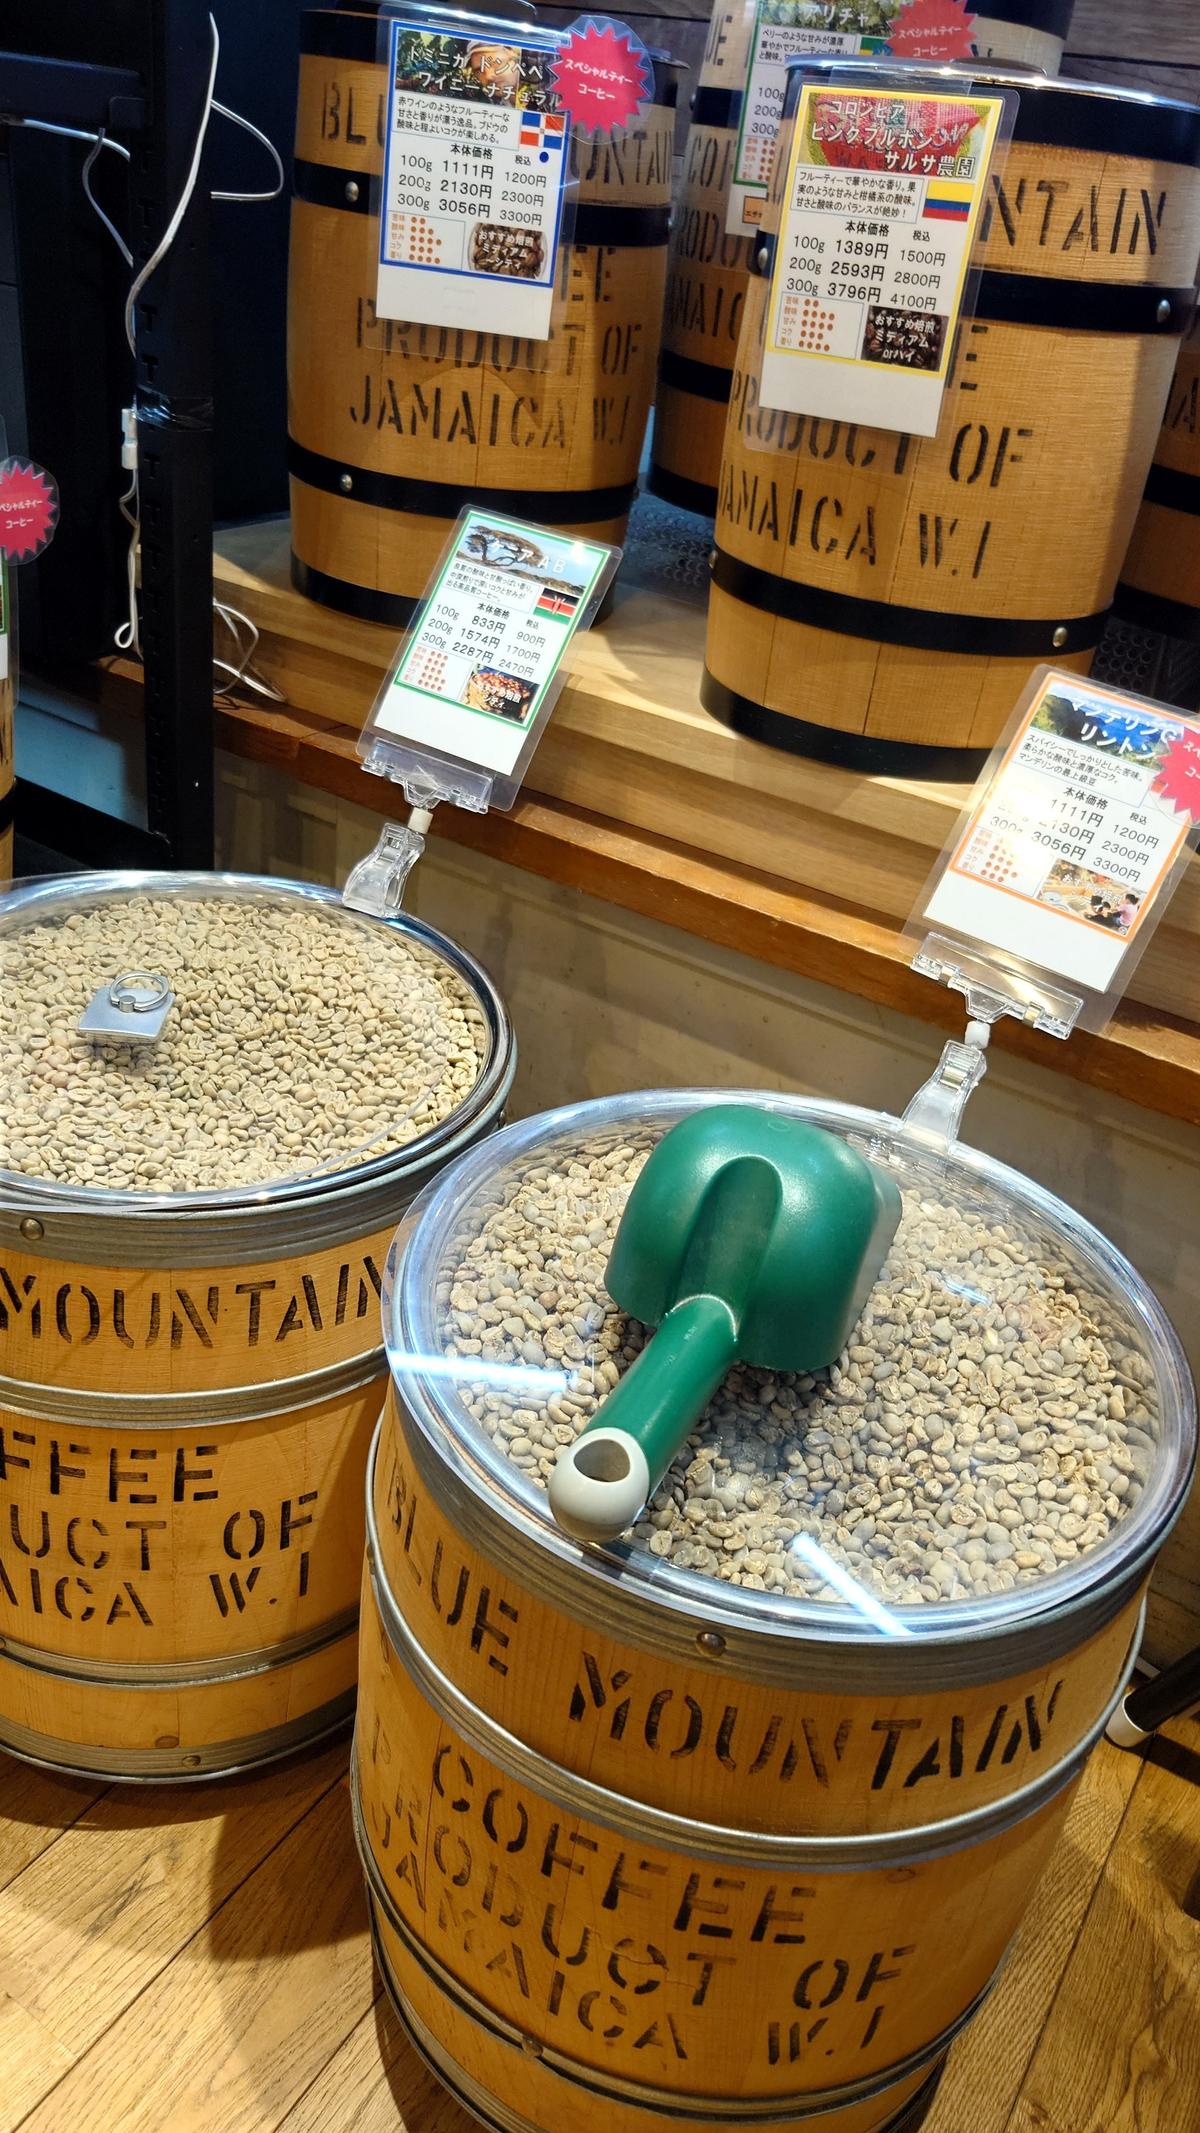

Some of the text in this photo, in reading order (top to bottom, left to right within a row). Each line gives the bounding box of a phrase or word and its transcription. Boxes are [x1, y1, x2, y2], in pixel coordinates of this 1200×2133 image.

[408, 43, 468, 70] ドミニカ
[913, 45, 948, 57] コーヒー
[577, 83, 617, 101] コーヒー
[398, 96, 511, 122] 赤ワインのようなフルーティーな
[401, 154, 547, 188] 100g 1111円 1200円
[450, 143, 531, 166] 本体価格 税込
[884, 152, 975, 179] サルサ農園
[399, 174, 544, 207] 200g 2130円 2300円
[397, 193, 542, 226] 300g 3056円 3300円
[845, 221, 930, 242] 本体価格 税込
[794, 235, 946, 267] 100g 1389円 1500円
[789, 257, 941, 289] 200g 2593円 2800円
[786, 278, 937, 311] 300g 3796円 4100円
[875, 314, 935, 333] おすすめ焙煎
[875, 329, 929, 348] ミディアム
[601, 324, 643, 376] OF
[350, 374, 566, 449] JAMAICA
[949, 423, 1034, 487] OF
[5, 517, 34, 529] コーヒー
[435, 604, 547, 648] 100g 833円 900円
[477, 602, 511, 620] 本体価格
[421, 632, 535, 678] 300g 2287円 2470円
[428, 618, 541, 663] 200g 1574円 1700円
[1080, 722, 1156, 760] リントン
[1019, 752, 1096, 787] マンデリンの最上級豆
[1023, 743, 1118, 784] 柔らかな酸味と濃厚なコク。
[1027, 734, 1143, 782] スパイシーでしっかりとした苦味。
[1064, 785, 1147, 825] 本体価格 税込
[1101, 840, 1149, 866] 2300円
[1113, 824, 1160, 849] 1200円
[1031, 831, 1086, 861] 3056円
[1093, 856, 1141, 882] 3300円
[223, 1491, 318, 1560] OF
[387, 1472, 519, 1676] BLUE
[569, 1650, 1064, 1790] MOUNTAIN
[432, 1743, 818, 1946] COFFEE
[792, 1943, 917, 2011] OF
